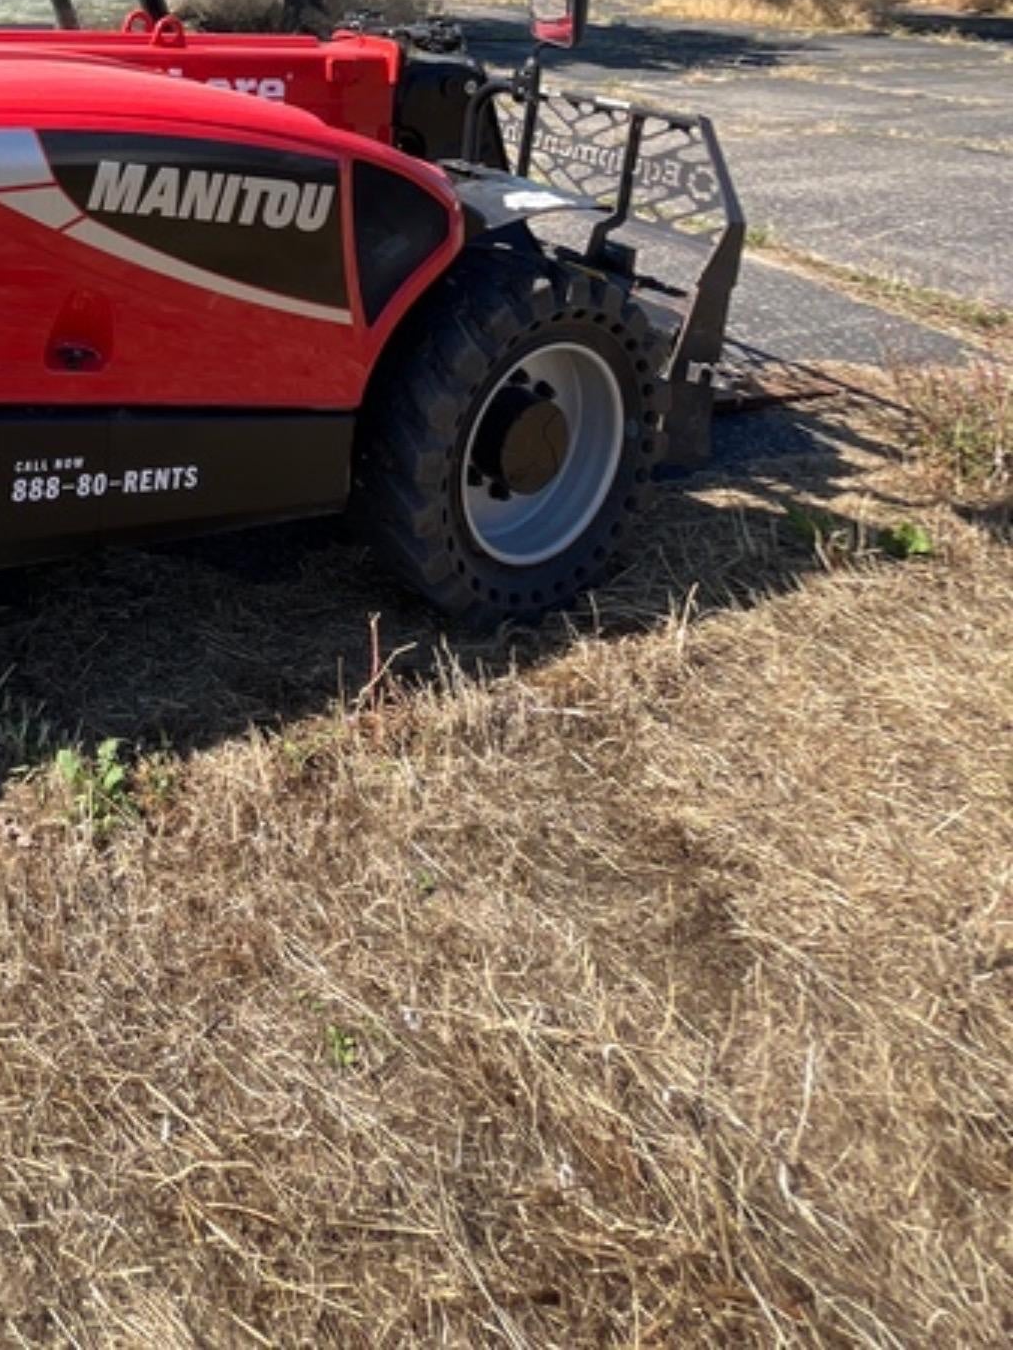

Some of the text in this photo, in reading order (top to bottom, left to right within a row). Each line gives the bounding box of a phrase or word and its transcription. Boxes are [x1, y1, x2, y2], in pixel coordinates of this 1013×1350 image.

[87, 160, 335, 232] MANITOU
[14, 457, 85, 472] CALL NOW
[12, 466, 199, 502] 888-80-RENTS
